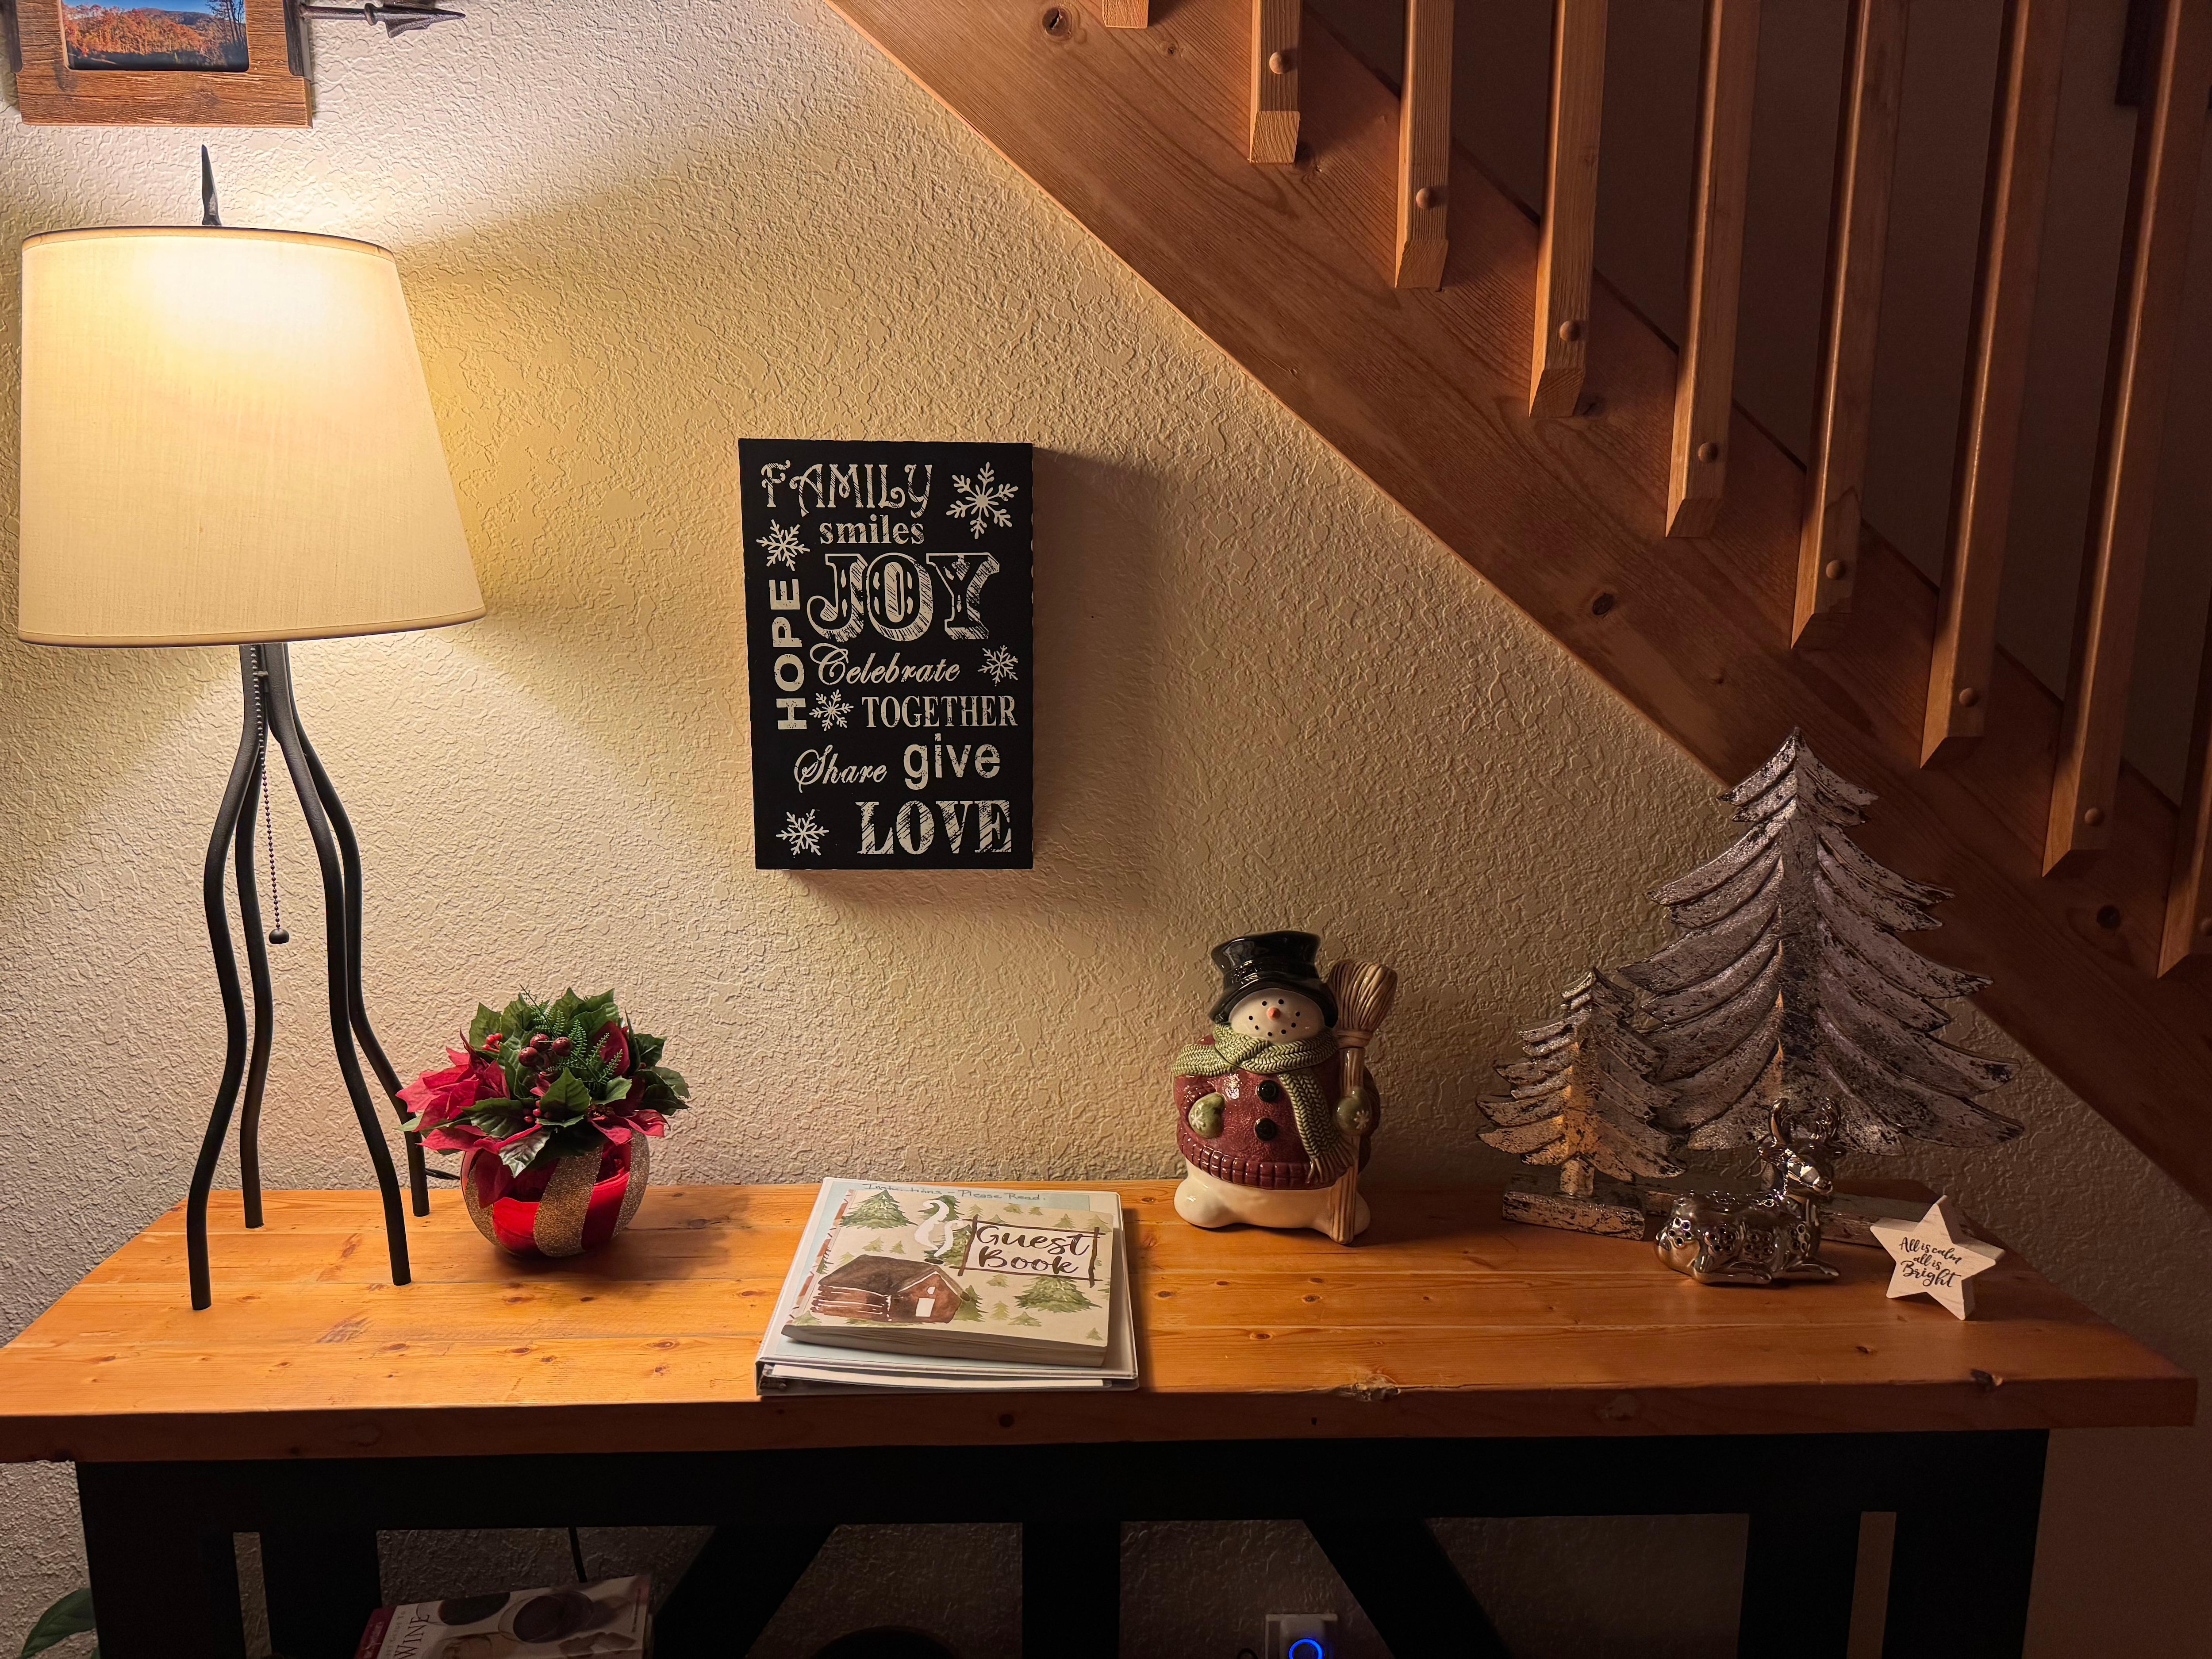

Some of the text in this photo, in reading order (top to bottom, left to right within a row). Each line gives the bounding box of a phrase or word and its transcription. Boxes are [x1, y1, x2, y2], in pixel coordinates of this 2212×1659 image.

[761, 460, 932, 518] FAMILY
[820, 514, 924, 544] smiles
[807, 552, 999, 642] JOY
[769, 579, 806, 730] HOPE
[810, 643, 960, 685] Celebrate
[862, 696, 1018, 727] TOGETHER
[794, 733, 1000, 793] Share give
[855, 800, 1011, 854] LOVE
[976, 1225, 1101, 1256] Guest
[1899, 1237, 1962, 1264] All is calm
[979, 1246, 1079, 1274] Book
[1901, 1260, 1962, 1287] Bright
[1913, 1253, 1942, 1270] all is
